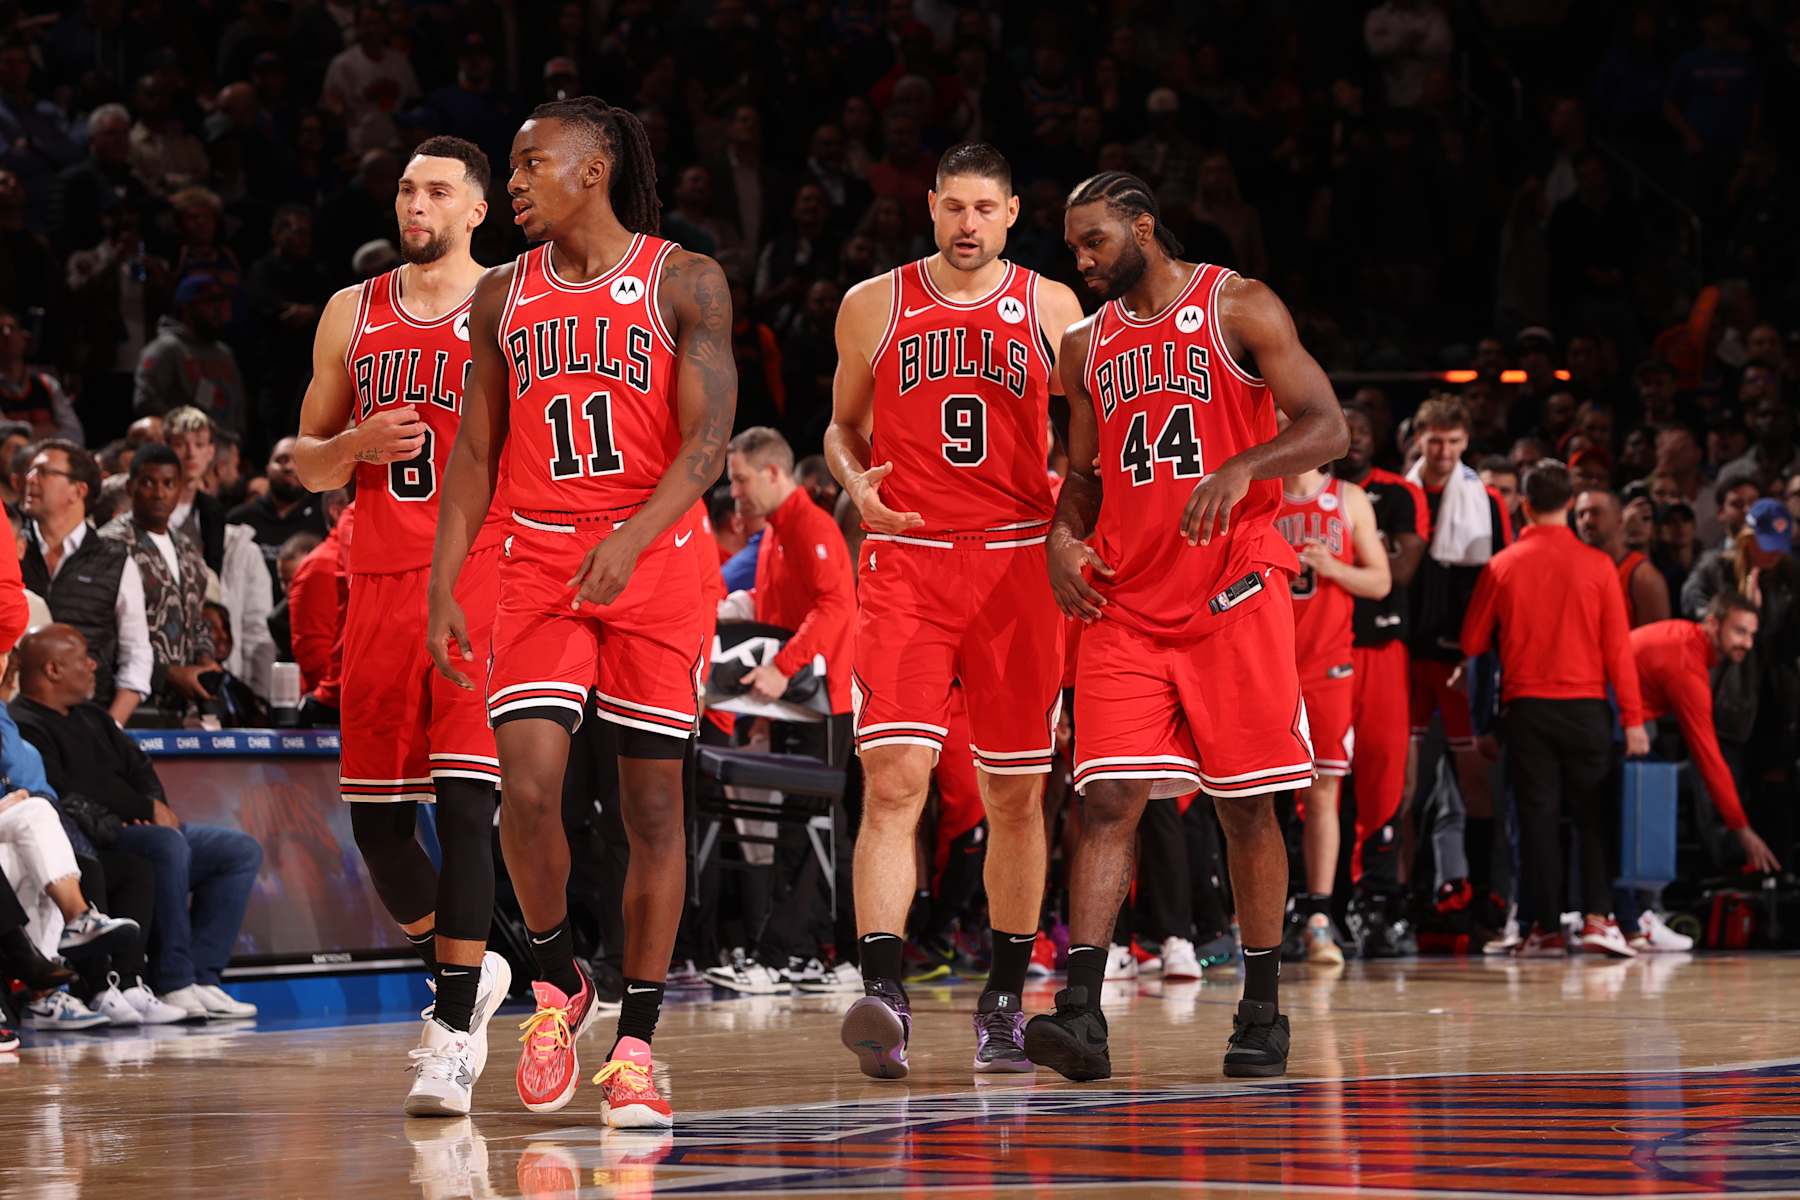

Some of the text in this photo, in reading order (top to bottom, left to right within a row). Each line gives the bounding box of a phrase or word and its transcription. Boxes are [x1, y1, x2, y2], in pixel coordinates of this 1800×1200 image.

[507, 316, 652, 400] BULLS
[898, 327, 1028, 399] BULLS
[1096, 341, 1212, 423] BULLS
[388, 422, 436, 502] 8
[544, 391, 625, 481] 11
[941, 394, 987, 467] 9
[1120, 403, 1204, 487] 44
[1274, 511, 1344, 556] ULLS
